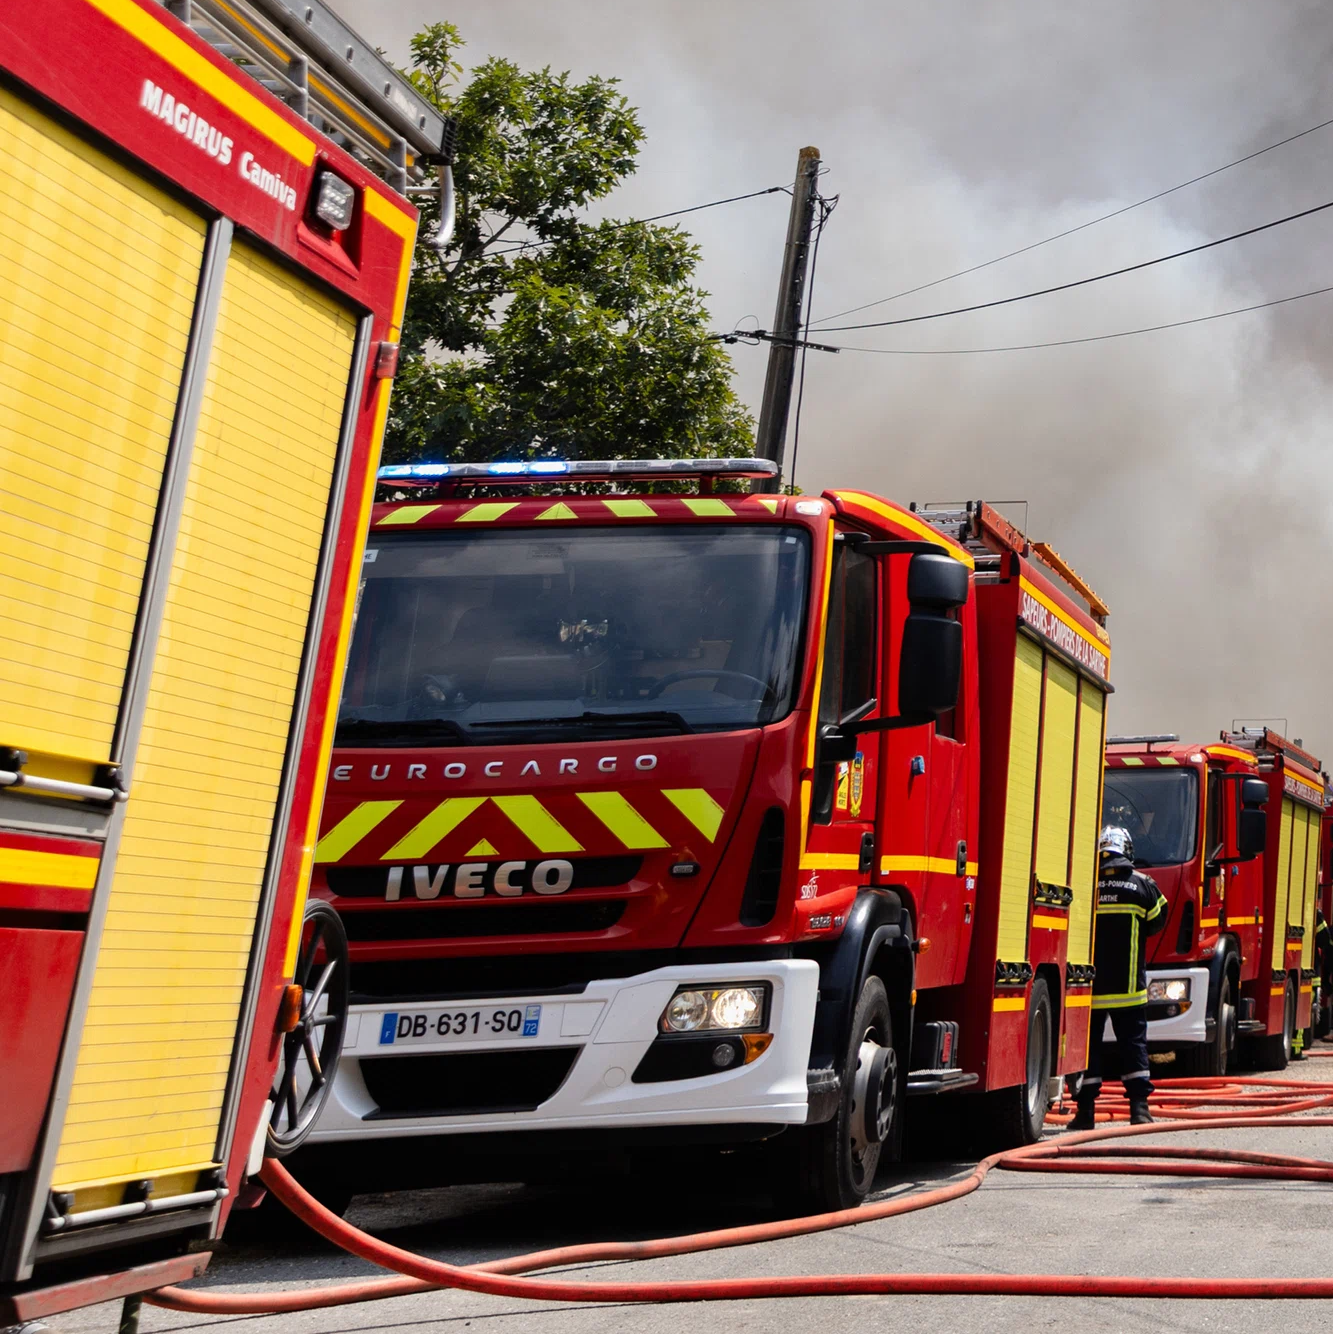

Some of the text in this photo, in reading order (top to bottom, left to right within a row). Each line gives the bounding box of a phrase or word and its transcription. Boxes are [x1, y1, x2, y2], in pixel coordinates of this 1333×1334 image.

[140, 79, 297, 211] MAGIRUS Camiva
[1075, 634, 1082, 661] DE
[1083, 640, 1089, 665] LA
[1089, 645, 1106, 678] SARTHE
[333, 754, 658, 781] EUROCARGO
[385, 859, 574, 901] IVECO
[1100, 894, 1118, 902] ARTHE
[397, 1009, 523, 1039] DB-631-SQ
[525, 1023, 537, 1034] 72
